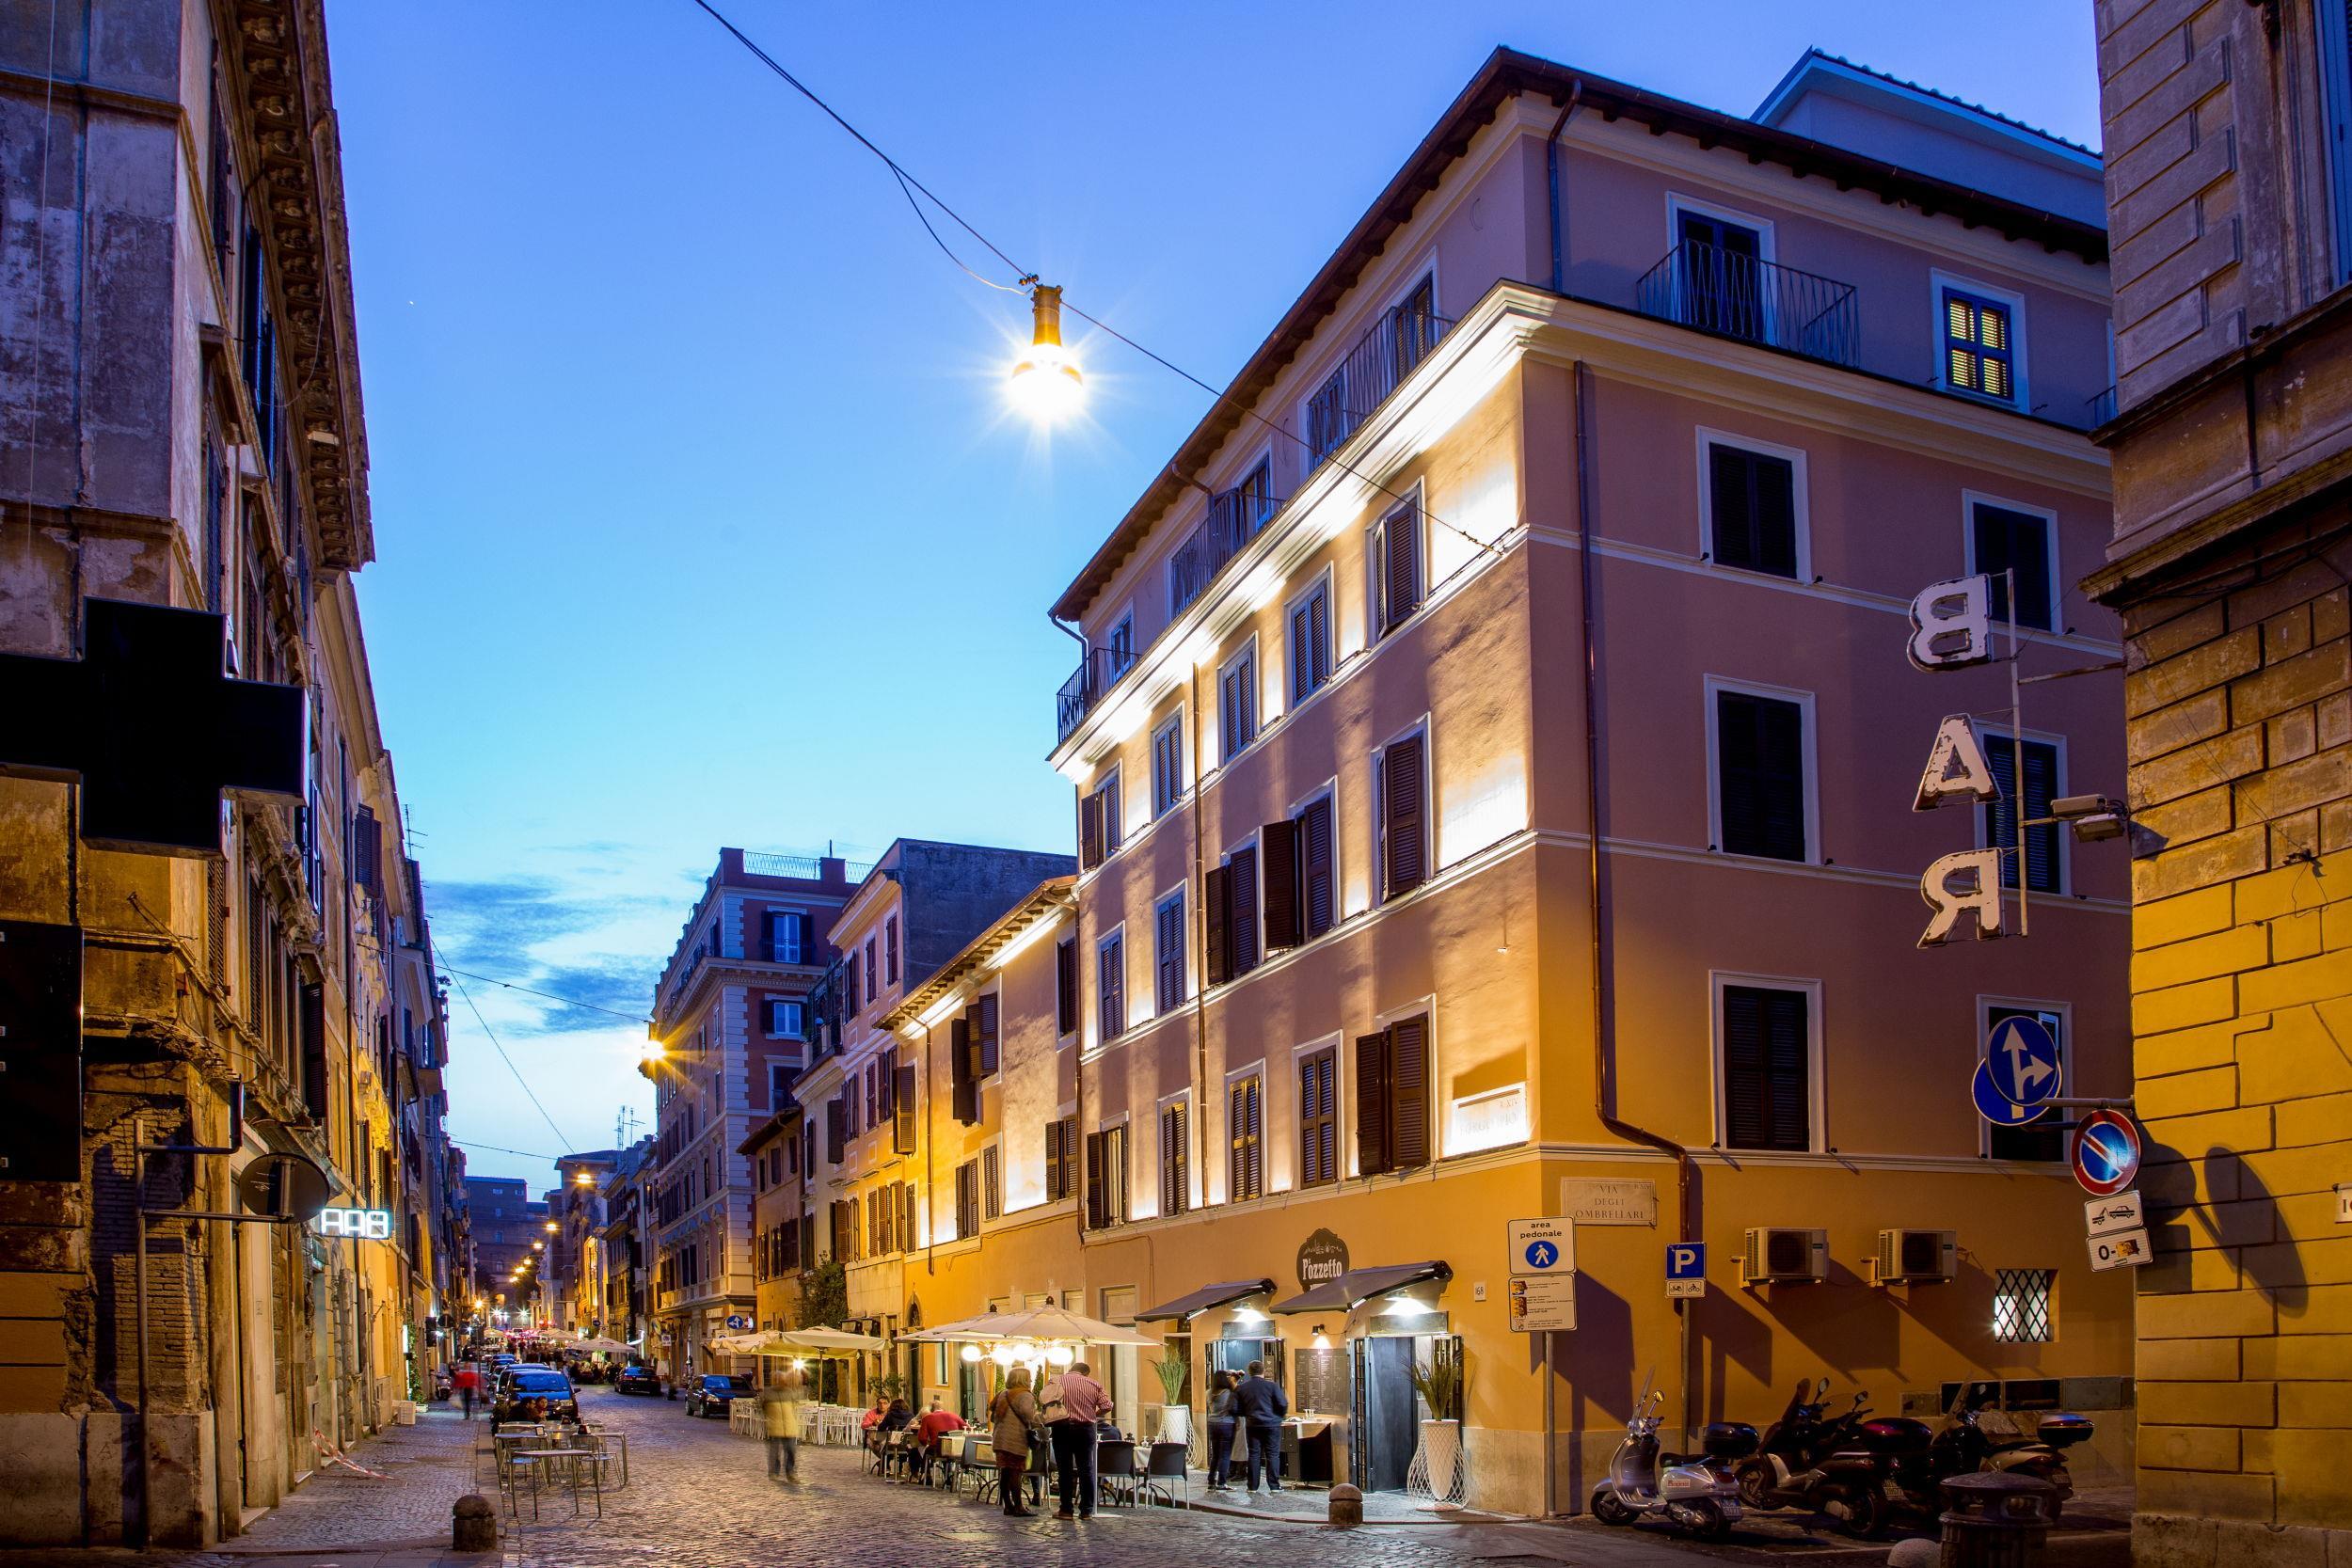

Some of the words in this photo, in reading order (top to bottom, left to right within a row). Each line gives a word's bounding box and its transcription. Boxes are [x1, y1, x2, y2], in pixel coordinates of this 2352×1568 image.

[1599, 1185, 1619, 1195] VIA
[1595, 1197, 1625, 1206] DEGLI
[1575, 1210, 1645, 1219] OMBRELLARI
[1519, 1230, 1563, 1240] pedonale
[1675, 1249, 1696, 1274] P
